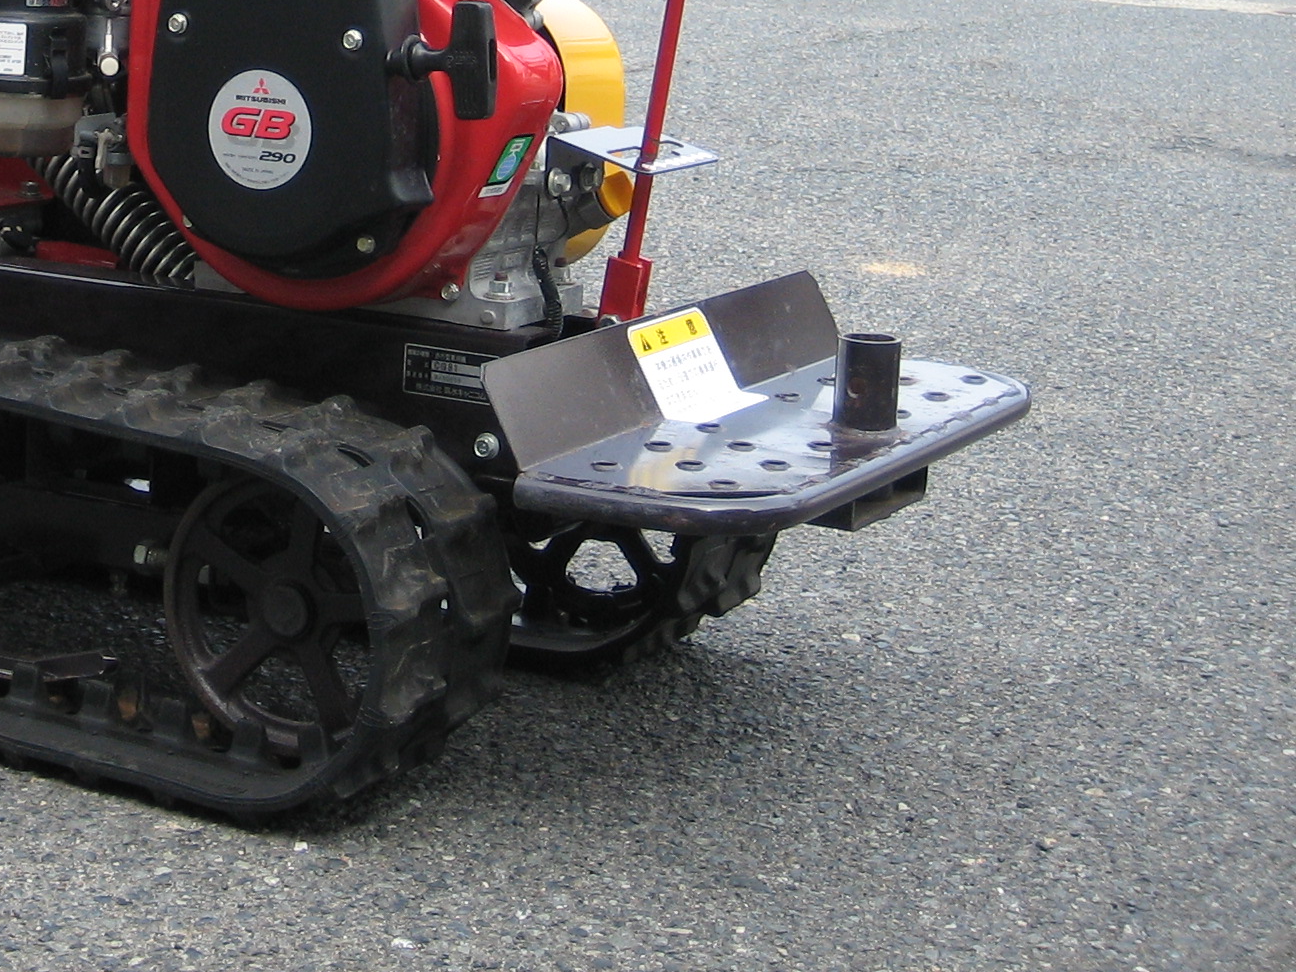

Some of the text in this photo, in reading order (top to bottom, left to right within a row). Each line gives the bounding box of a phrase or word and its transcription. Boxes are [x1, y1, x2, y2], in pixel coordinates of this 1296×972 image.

[236, 94, 287, 105] MITSUBISHI
[221, 107, 296, 140] GB
[259, 151, 296, 164] 290
